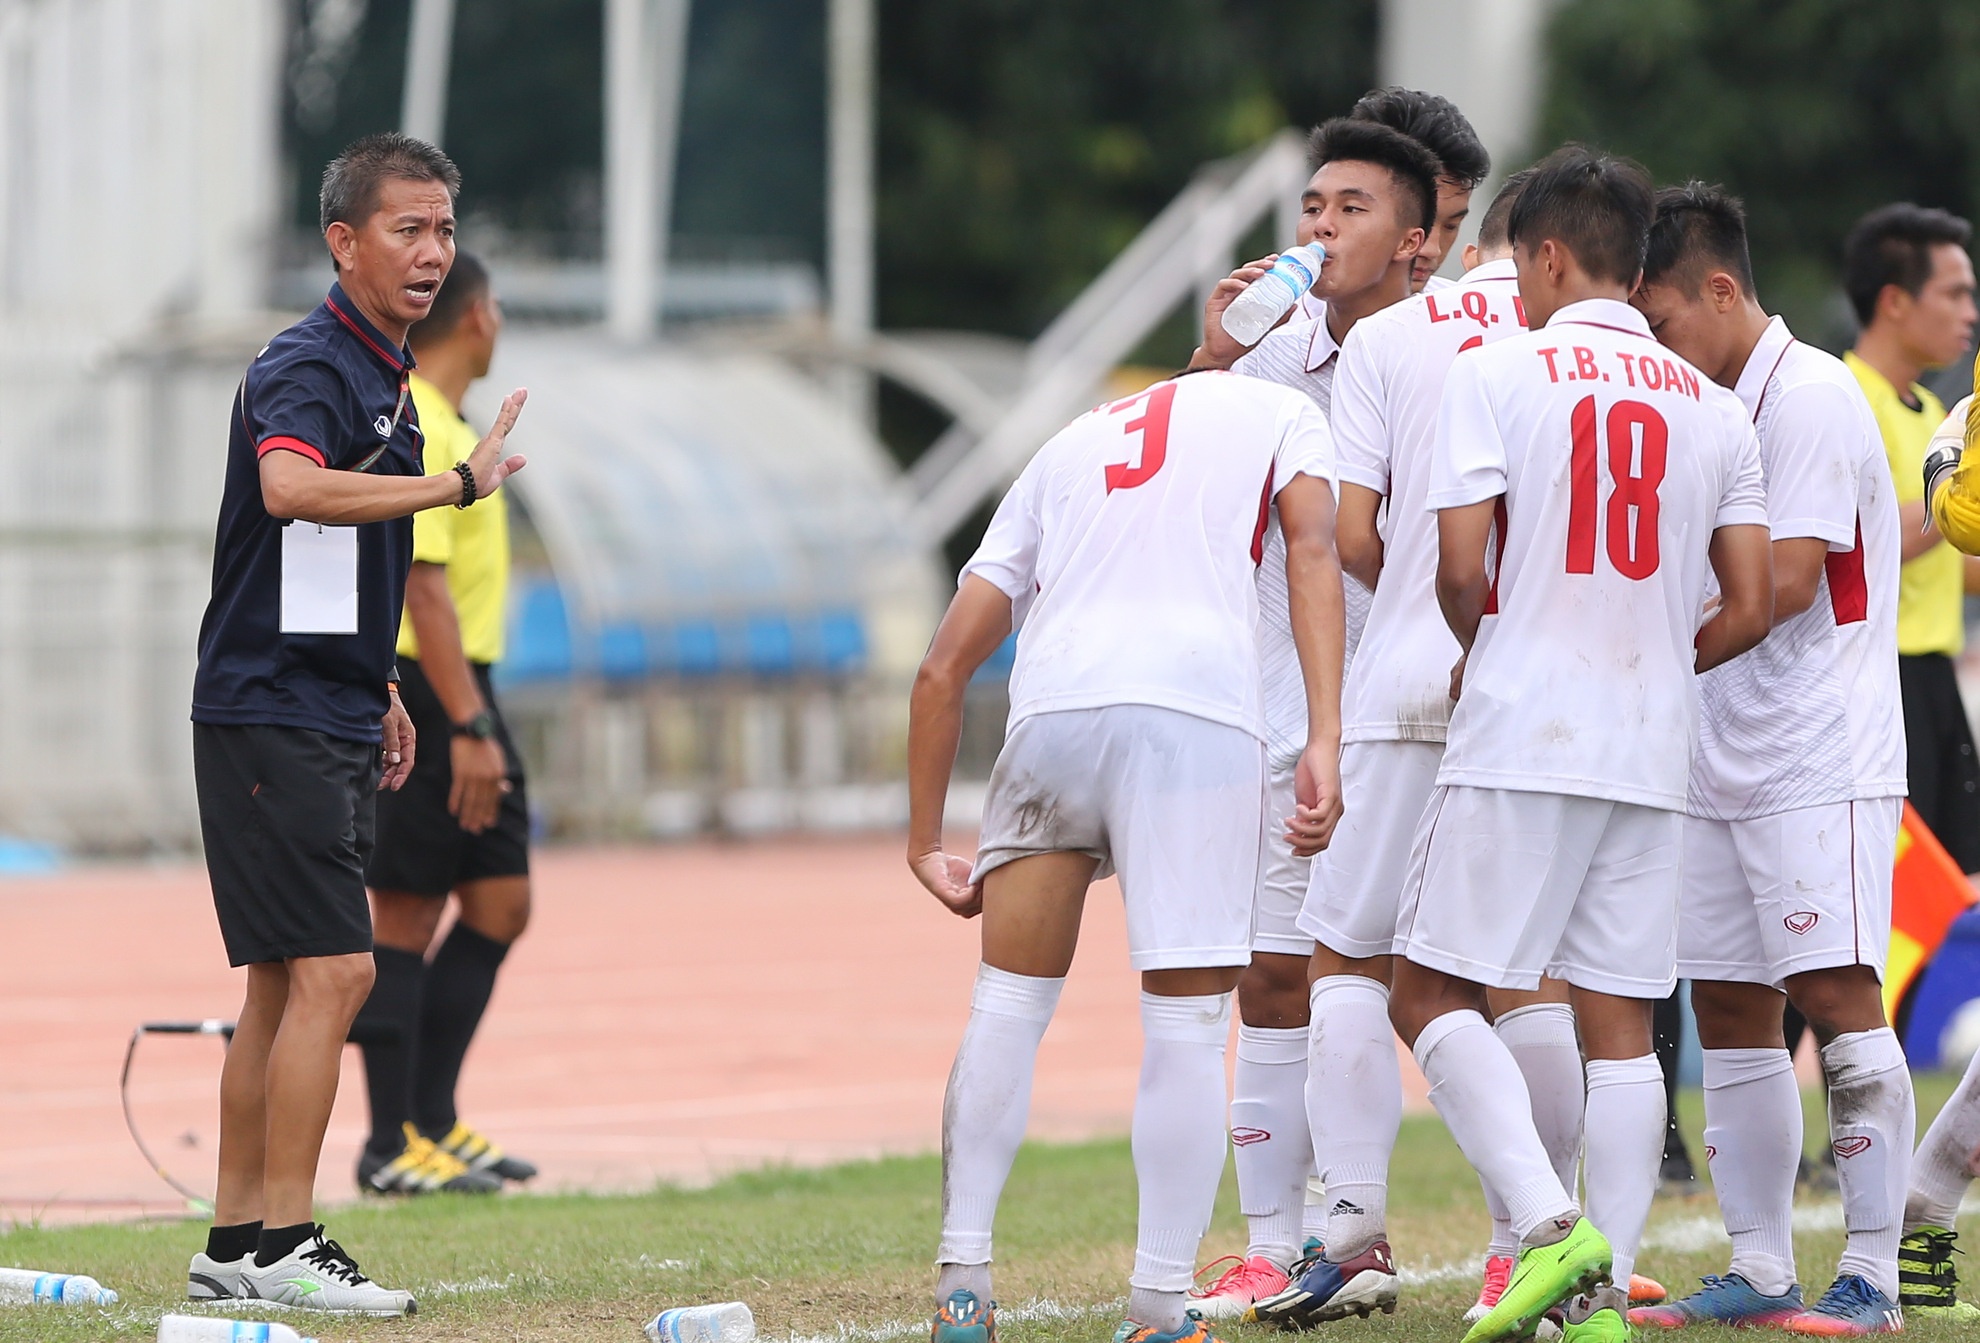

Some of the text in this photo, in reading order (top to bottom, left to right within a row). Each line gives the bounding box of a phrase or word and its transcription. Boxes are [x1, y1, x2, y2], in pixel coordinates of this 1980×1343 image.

[1425, 291, 1499, 329] L.Q.
[1536, 346, 1700, 402] T.B. TOAN
[1104, 376, 1178, 497] 3
[1565, 394, 1669, 581] 18
